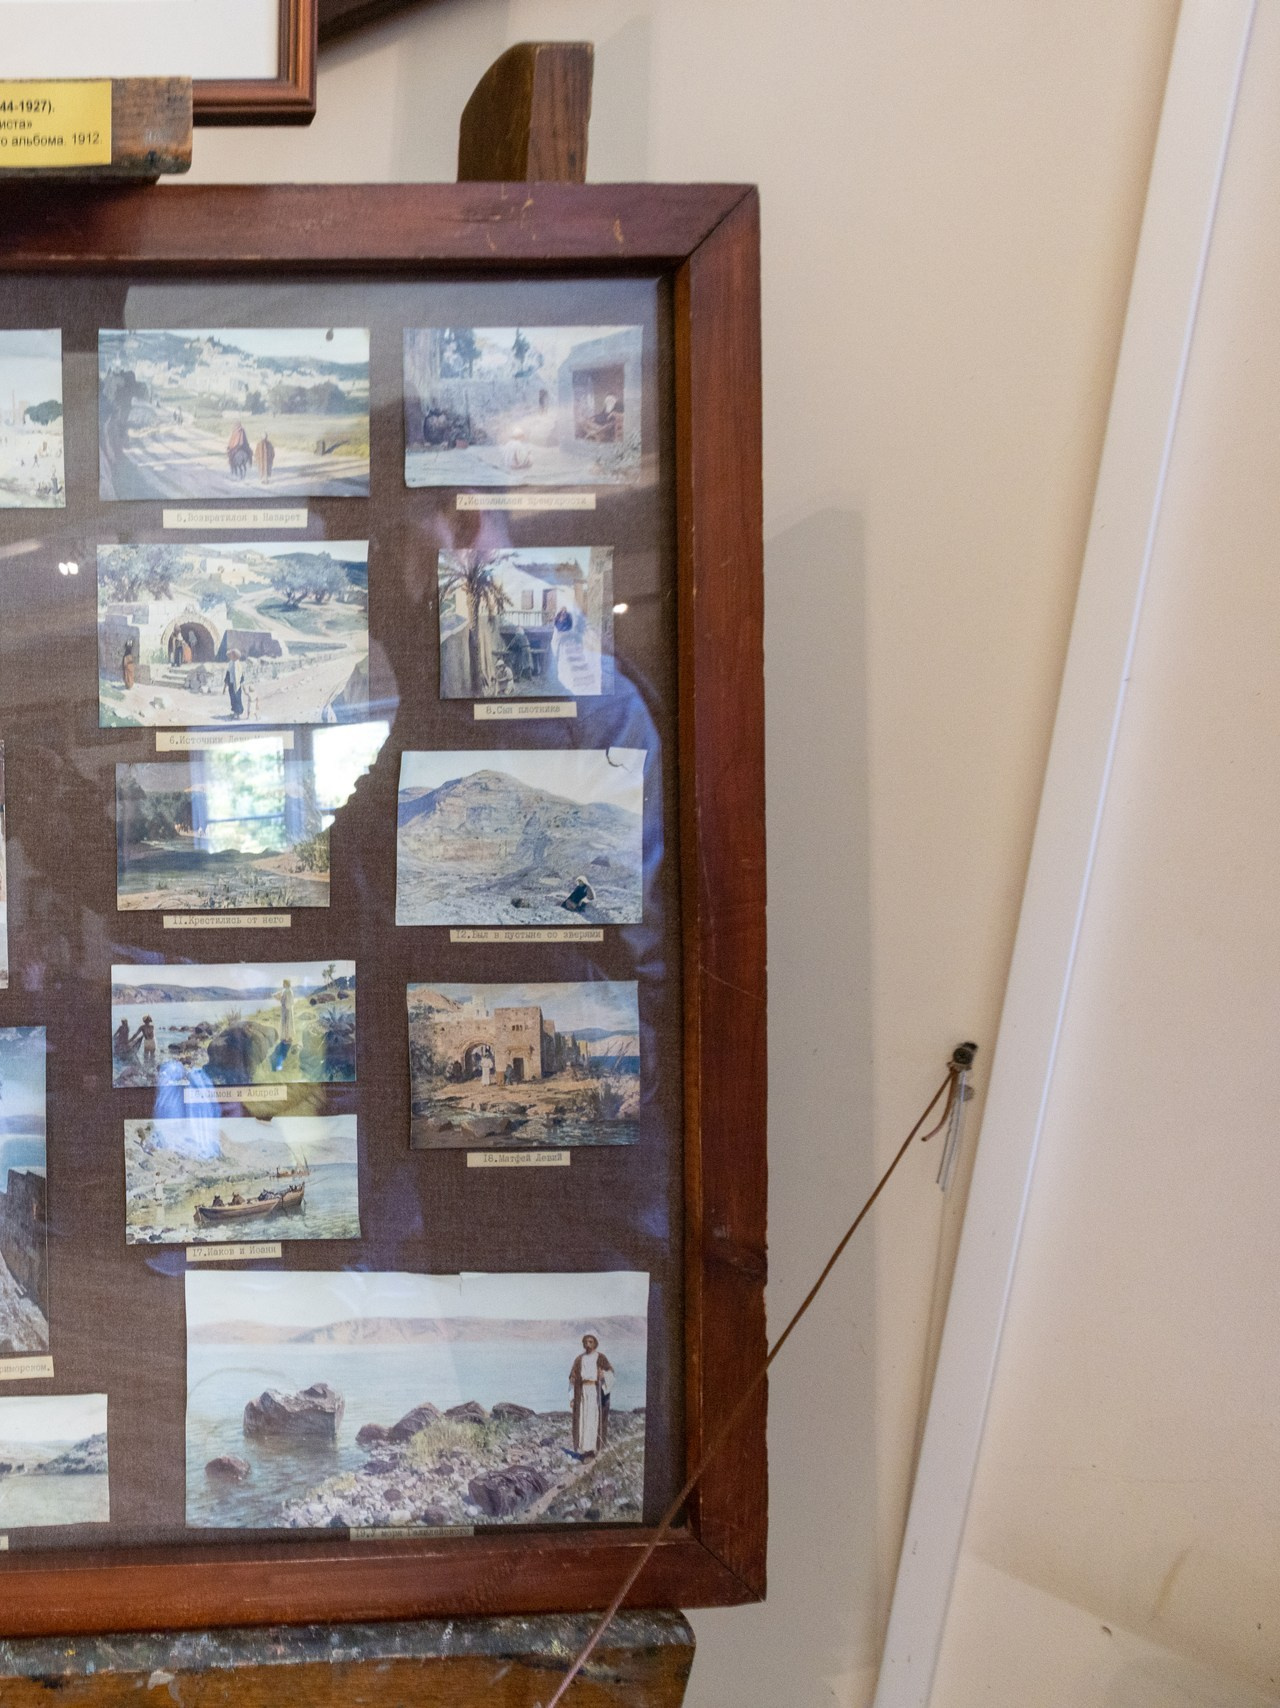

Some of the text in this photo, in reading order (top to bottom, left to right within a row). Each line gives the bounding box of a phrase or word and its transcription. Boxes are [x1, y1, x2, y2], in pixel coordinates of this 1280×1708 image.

[505, 931, 542, 940] пустыне
[563, 930, 601, 940] зверями
[247, 1087, 279, 1098] Андрей
[535, 1153, 563, 1162] Левий
[249, 1246, 276, 1255] Иоанн
